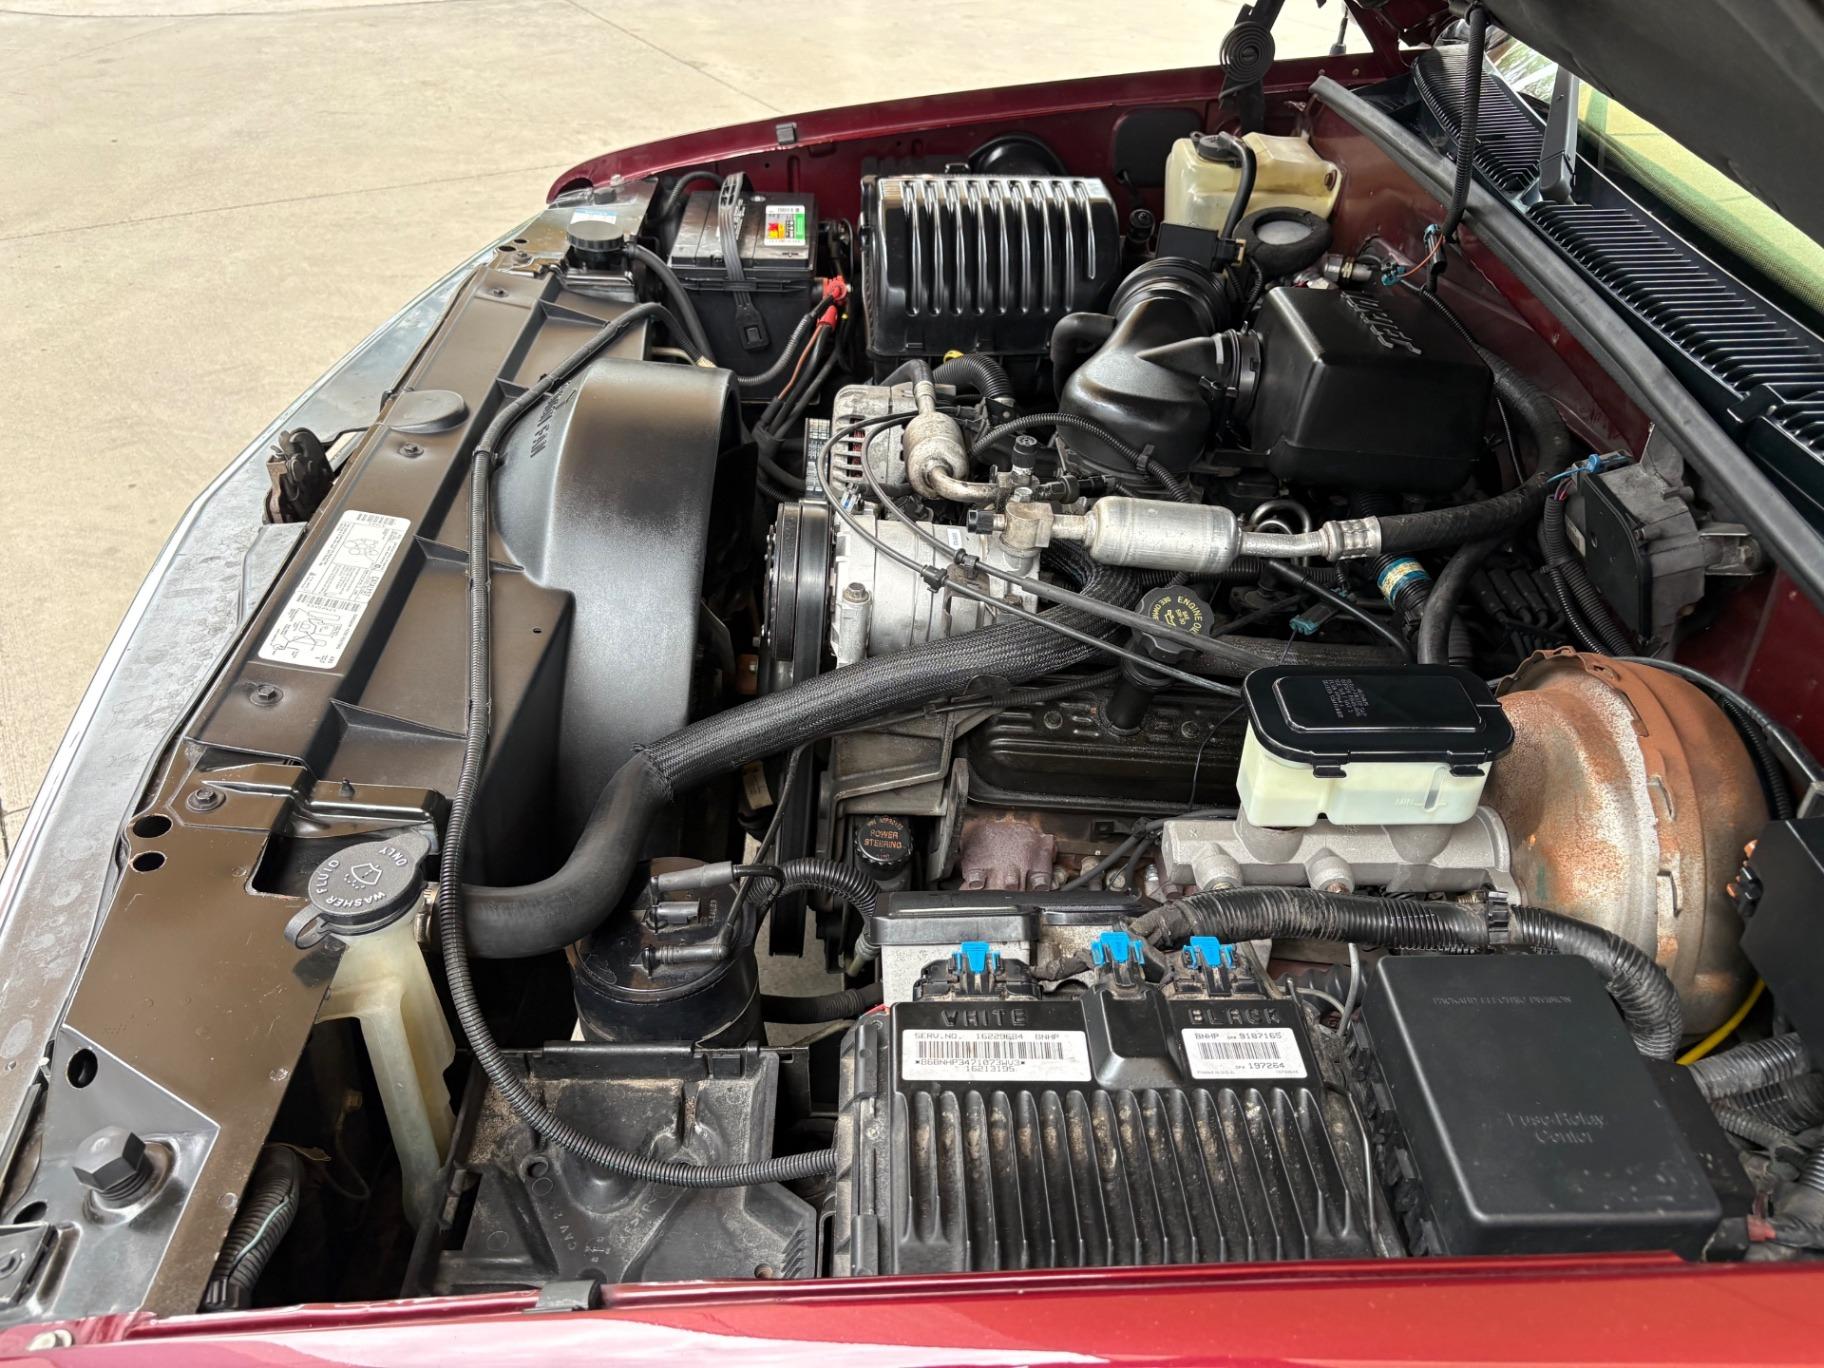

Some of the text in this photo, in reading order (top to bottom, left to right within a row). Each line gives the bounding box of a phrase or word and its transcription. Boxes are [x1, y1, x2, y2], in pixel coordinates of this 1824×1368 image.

[1177, 595, 1203, 622] ENGINE
[870, 829, 899, 839] POWER
[864, 838, 902, 849] STEERING
[316, 846, 408, 908] WASHER FLUID ONLY
[941, 1009, 1027, 1027] WHITE
[1188, 1007, 1280, 1025] BLACK
[1535, 1131, 1593, 1144] Center
